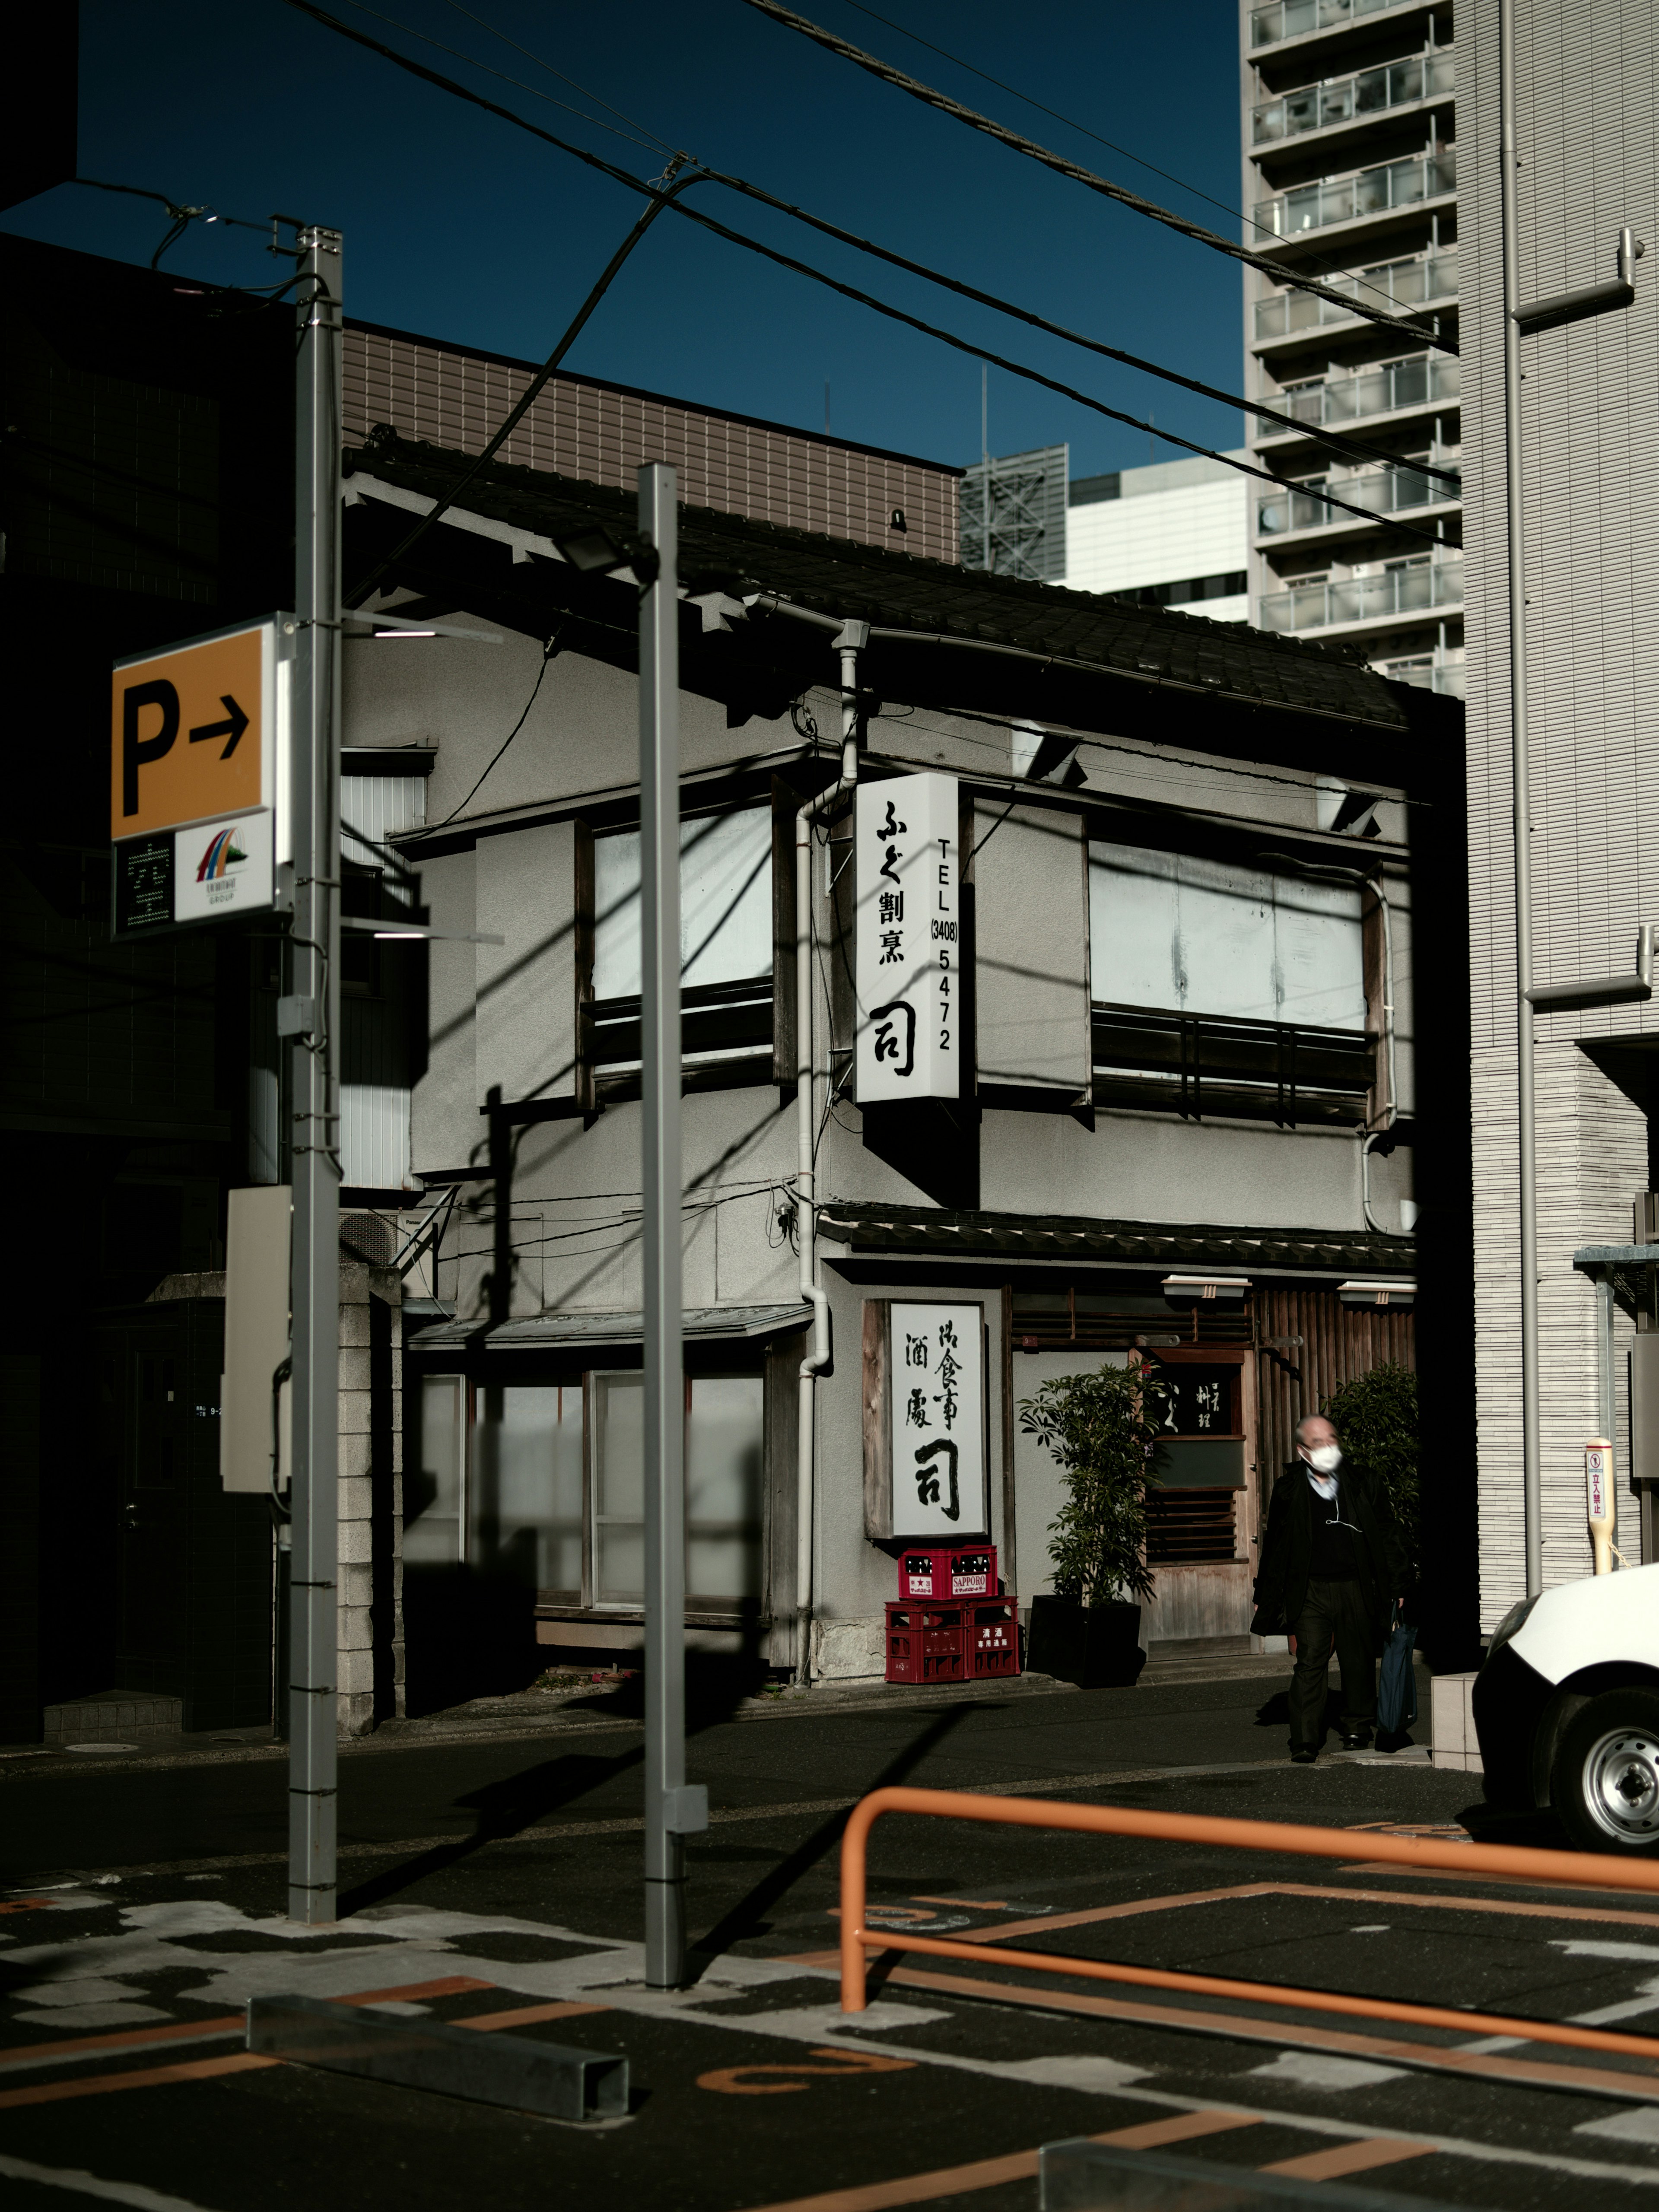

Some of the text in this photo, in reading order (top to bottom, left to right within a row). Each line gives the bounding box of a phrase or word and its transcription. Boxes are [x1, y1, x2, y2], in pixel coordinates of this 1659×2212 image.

[124, 679, 180, 817] P
[127, 843, 169, 927] 空
[207, 877, 236, 893] UNIMAT
[210, 893, 235, 905] GROUP
[869, 801, 916, 1077] ふぐ割烹 司
[931, 839, 957, 1050] TEL (3408) 5472
[1196, 1386, 1211, 1427] 料理
[915, 1438, 960, 1521] 司
[954, 1576, 985, 1587] SAPPORO
[982, 1627, 1002, 1638] 清酒
